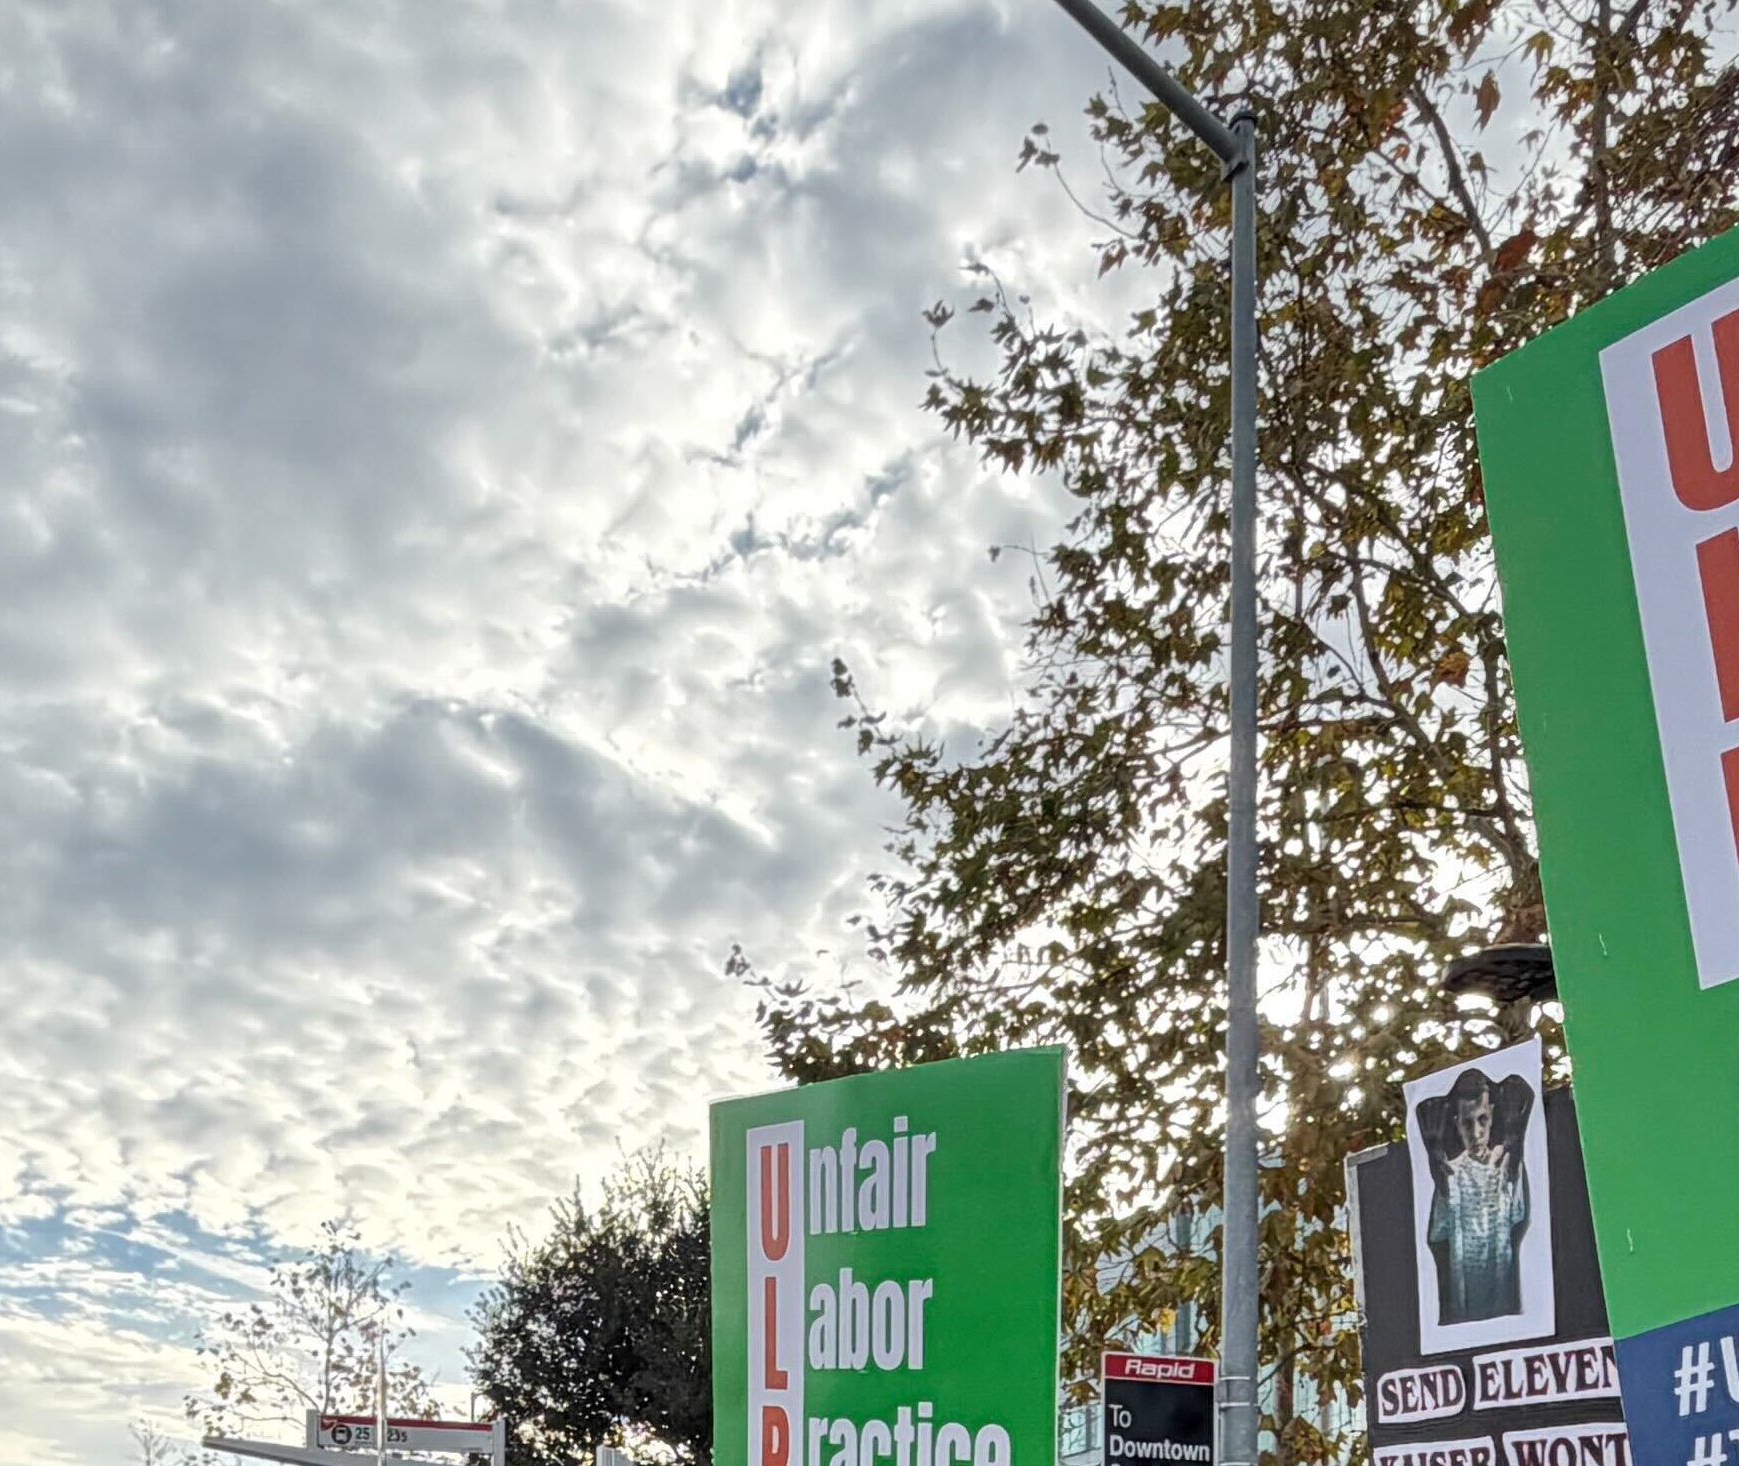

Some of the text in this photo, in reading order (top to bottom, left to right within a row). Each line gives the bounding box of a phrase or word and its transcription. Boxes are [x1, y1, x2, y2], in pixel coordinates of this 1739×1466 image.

[1125, 1359, 1195, 1379] Rapid
[1381, 1368, 1461, 1417] SEND
[1109, 1404, 1131, 1428] To
[1110, 1435, 1210, 1462] Downtown
